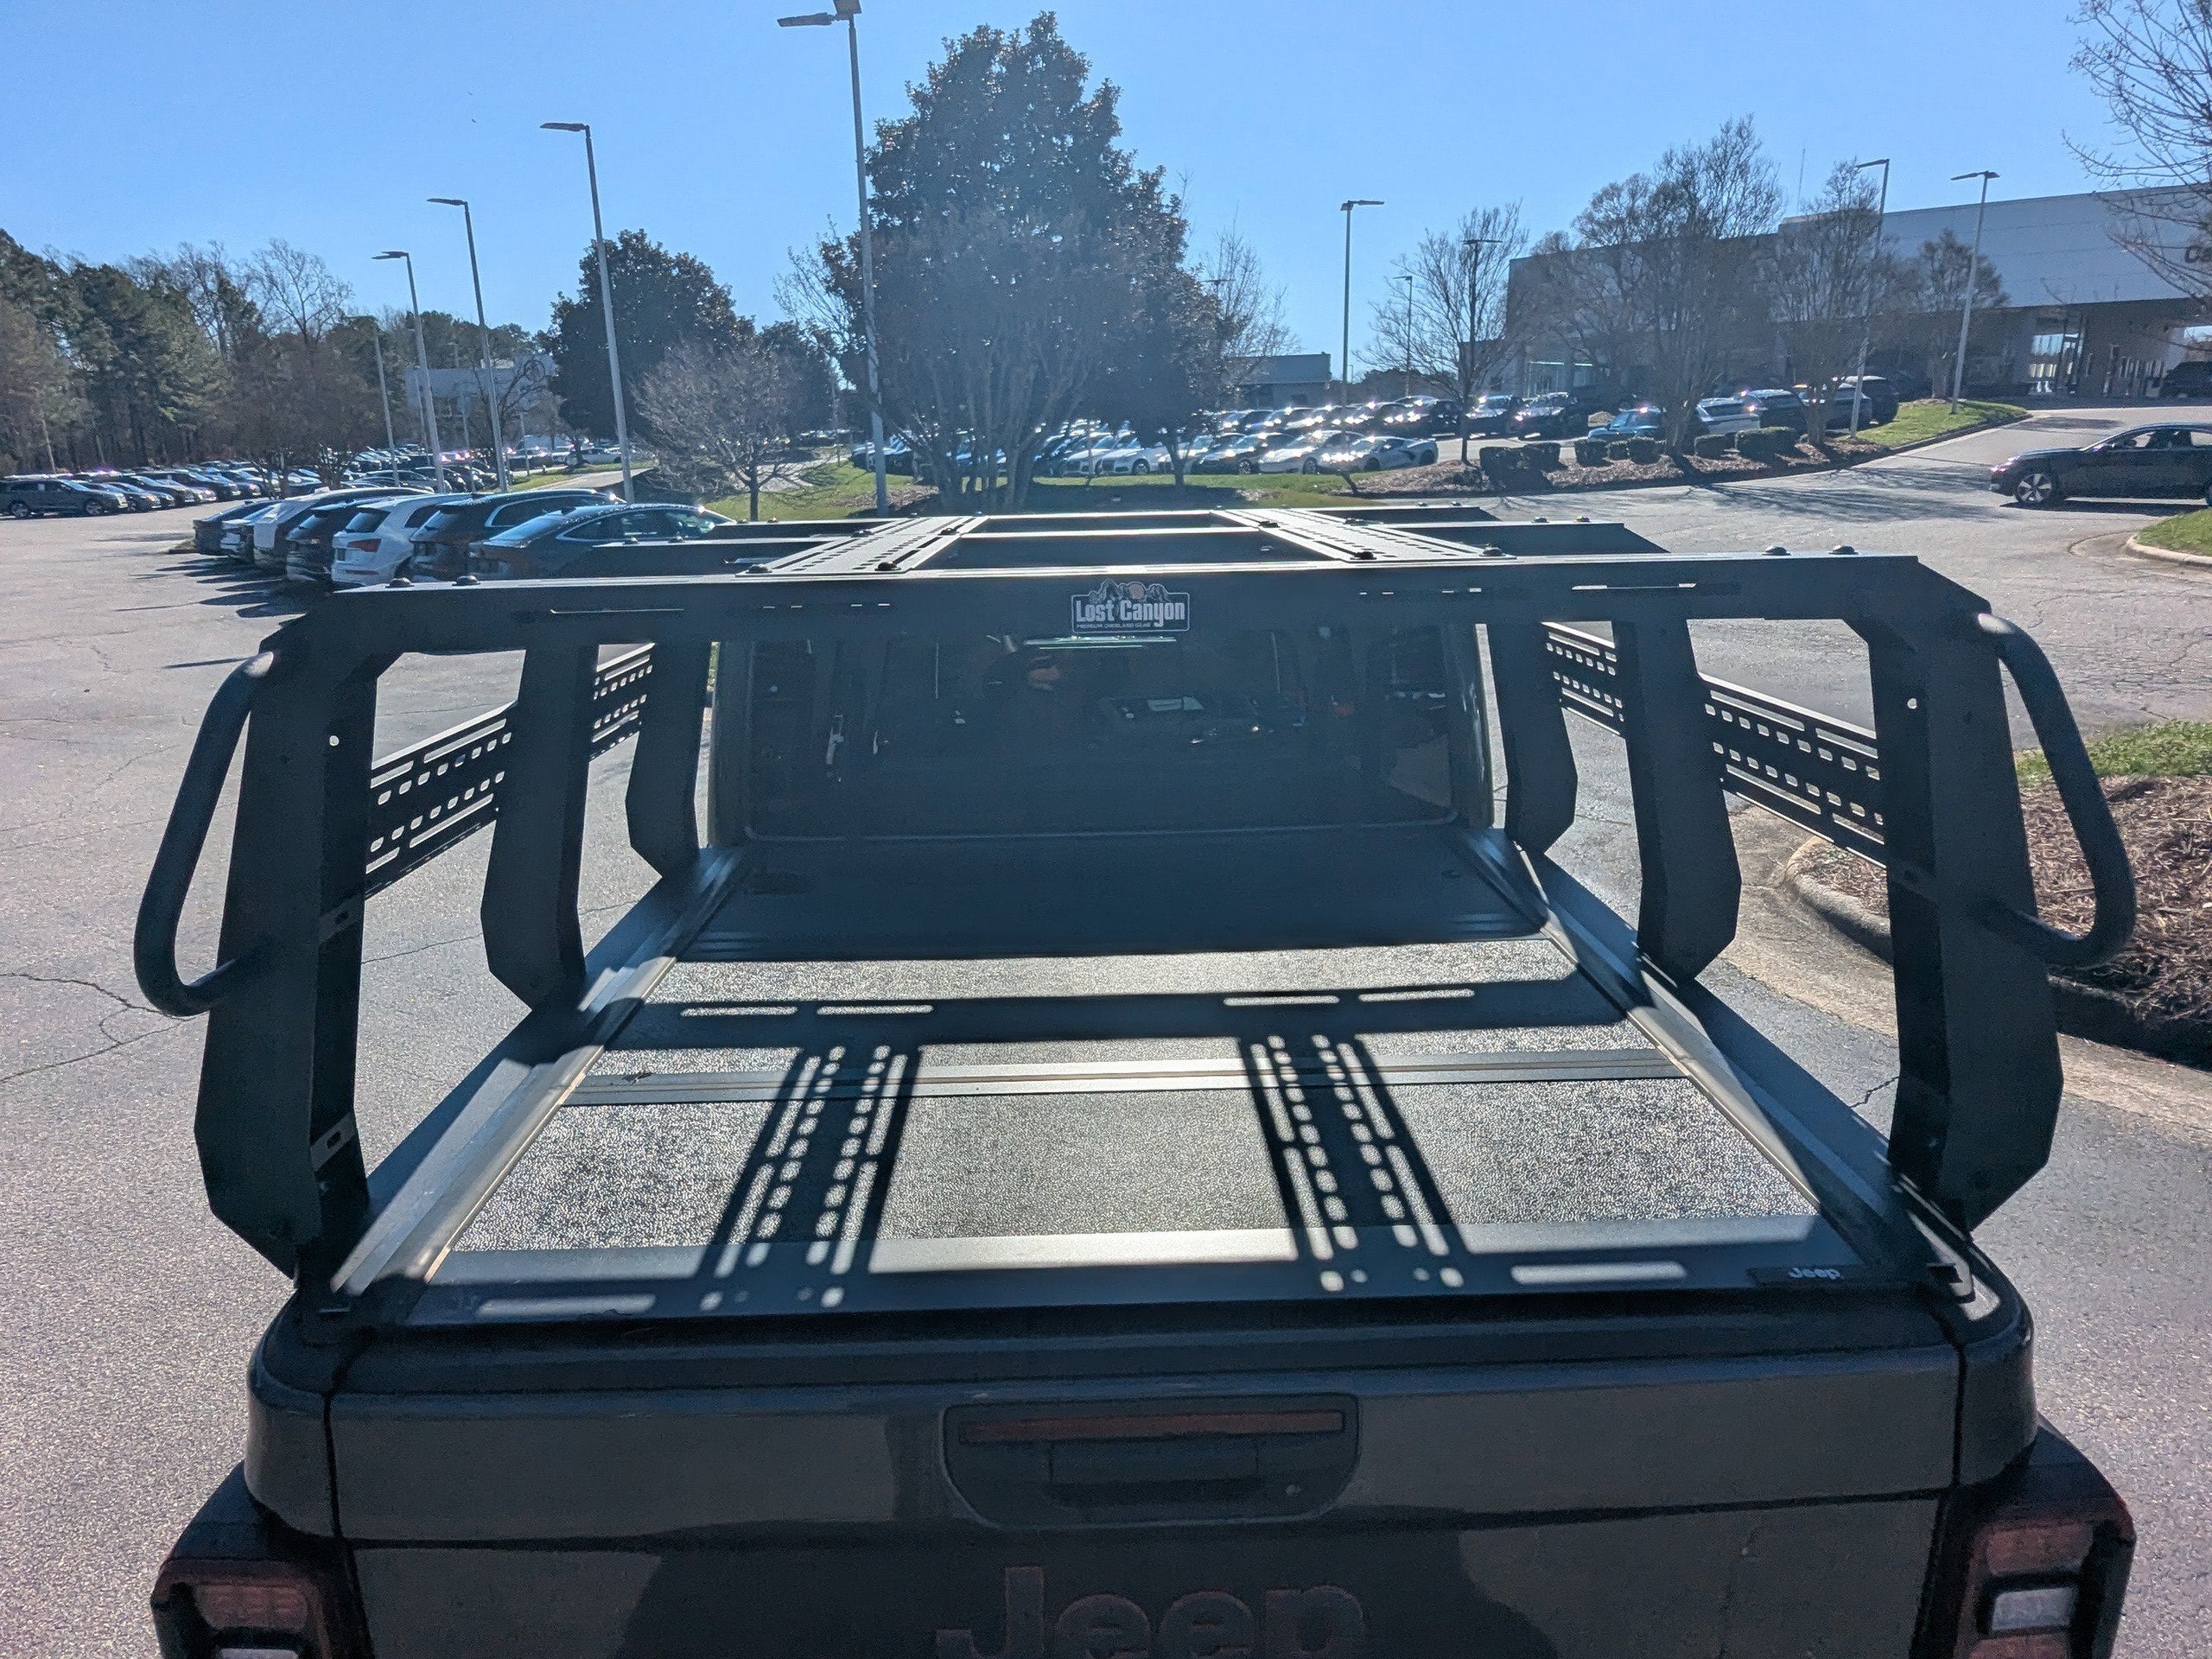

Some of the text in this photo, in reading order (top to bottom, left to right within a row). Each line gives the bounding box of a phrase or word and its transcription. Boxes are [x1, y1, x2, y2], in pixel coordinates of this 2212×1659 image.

[1076, 600, 1185, 627] Lost Canyon
[1788, 1267, 1841, 1280] Jeep
[935, 1565, 1367, 1659] Jeep
